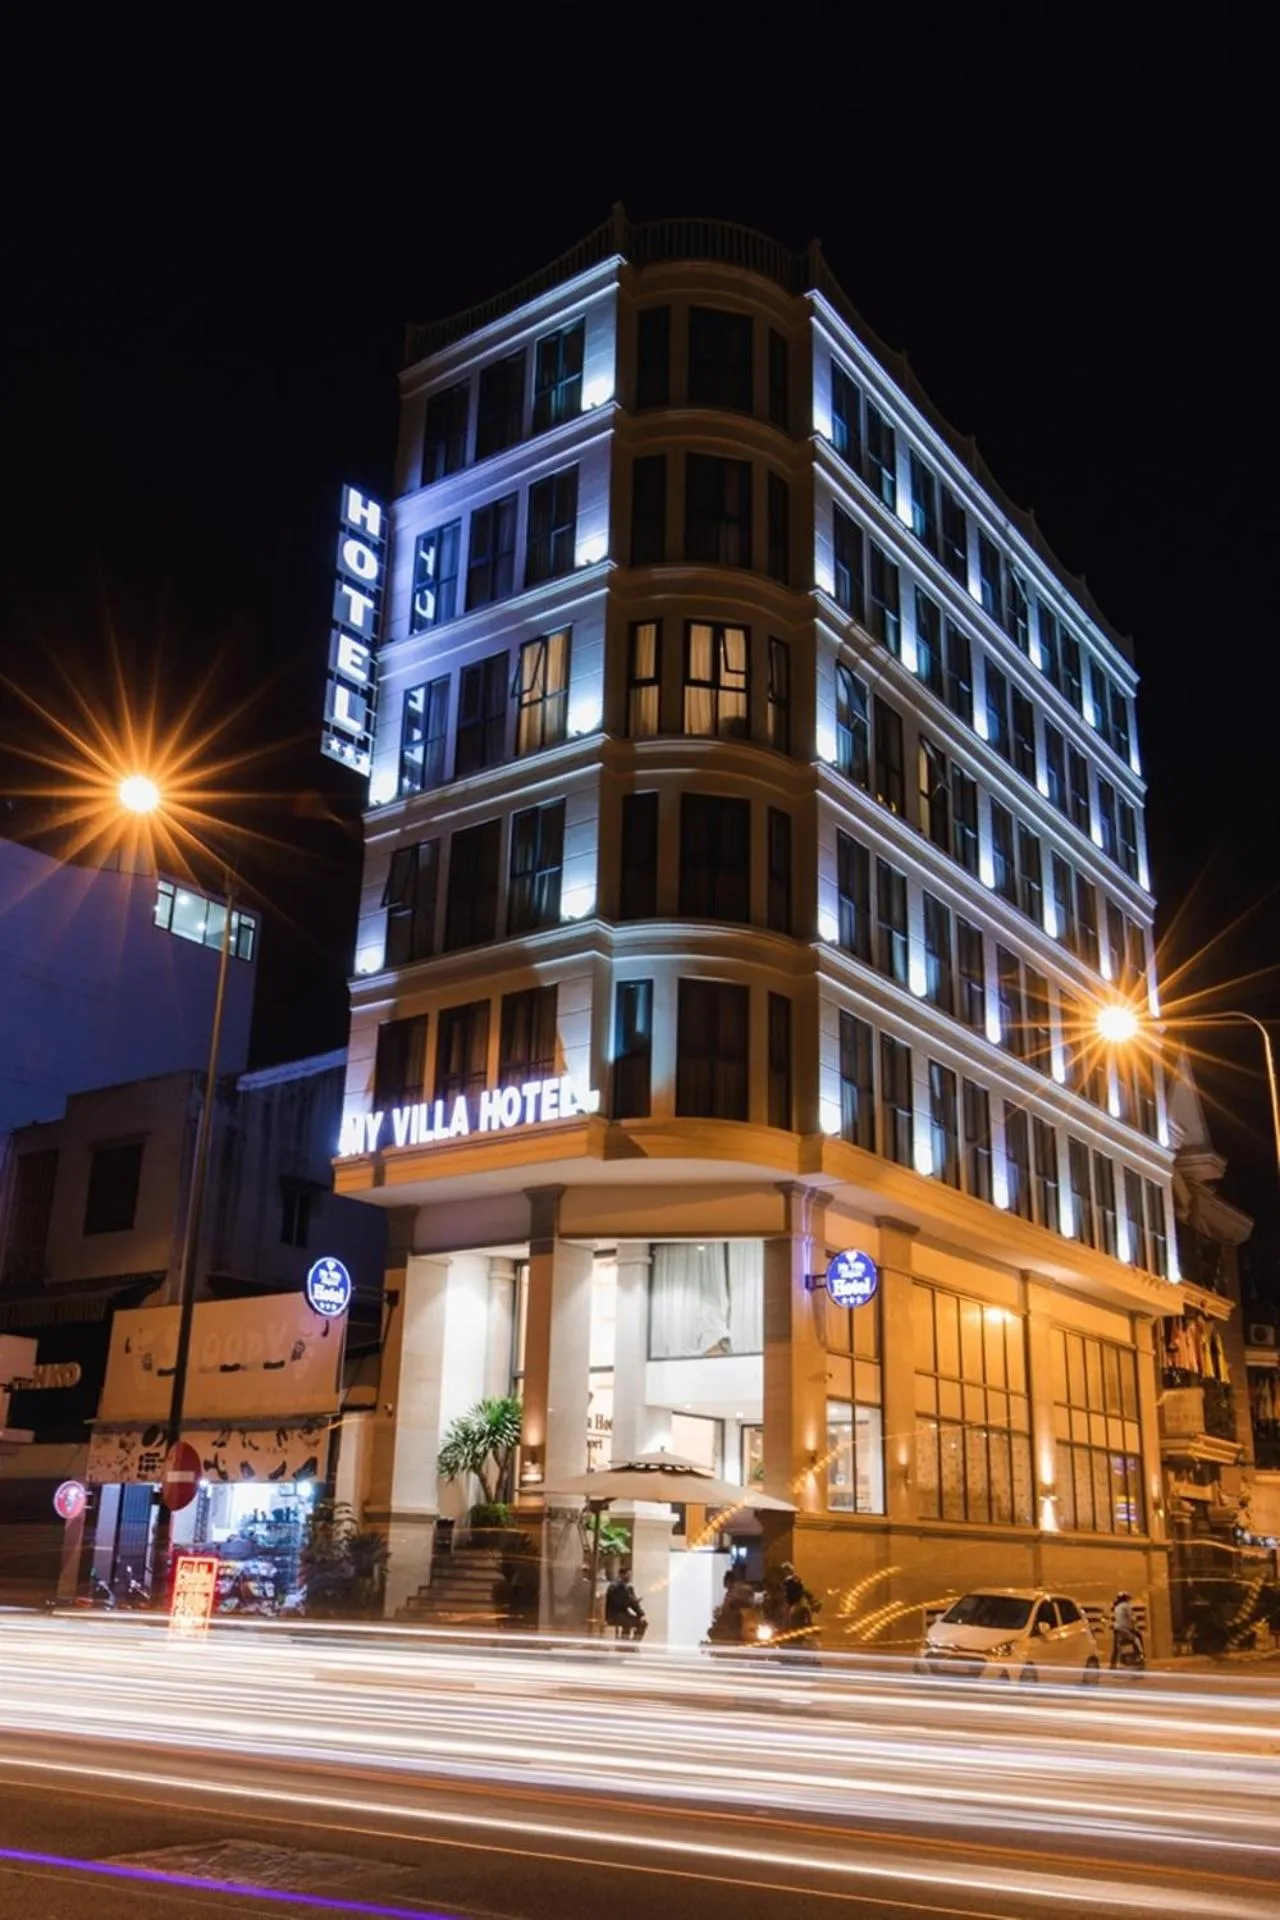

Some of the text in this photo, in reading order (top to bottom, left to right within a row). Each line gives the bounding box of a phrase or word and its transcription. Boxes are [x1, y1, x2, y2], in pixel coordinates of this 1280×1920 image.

[334, 486, 381, 733] HOTEL
[339, 1075, 578, 1157] MY VILLA HOTEL
